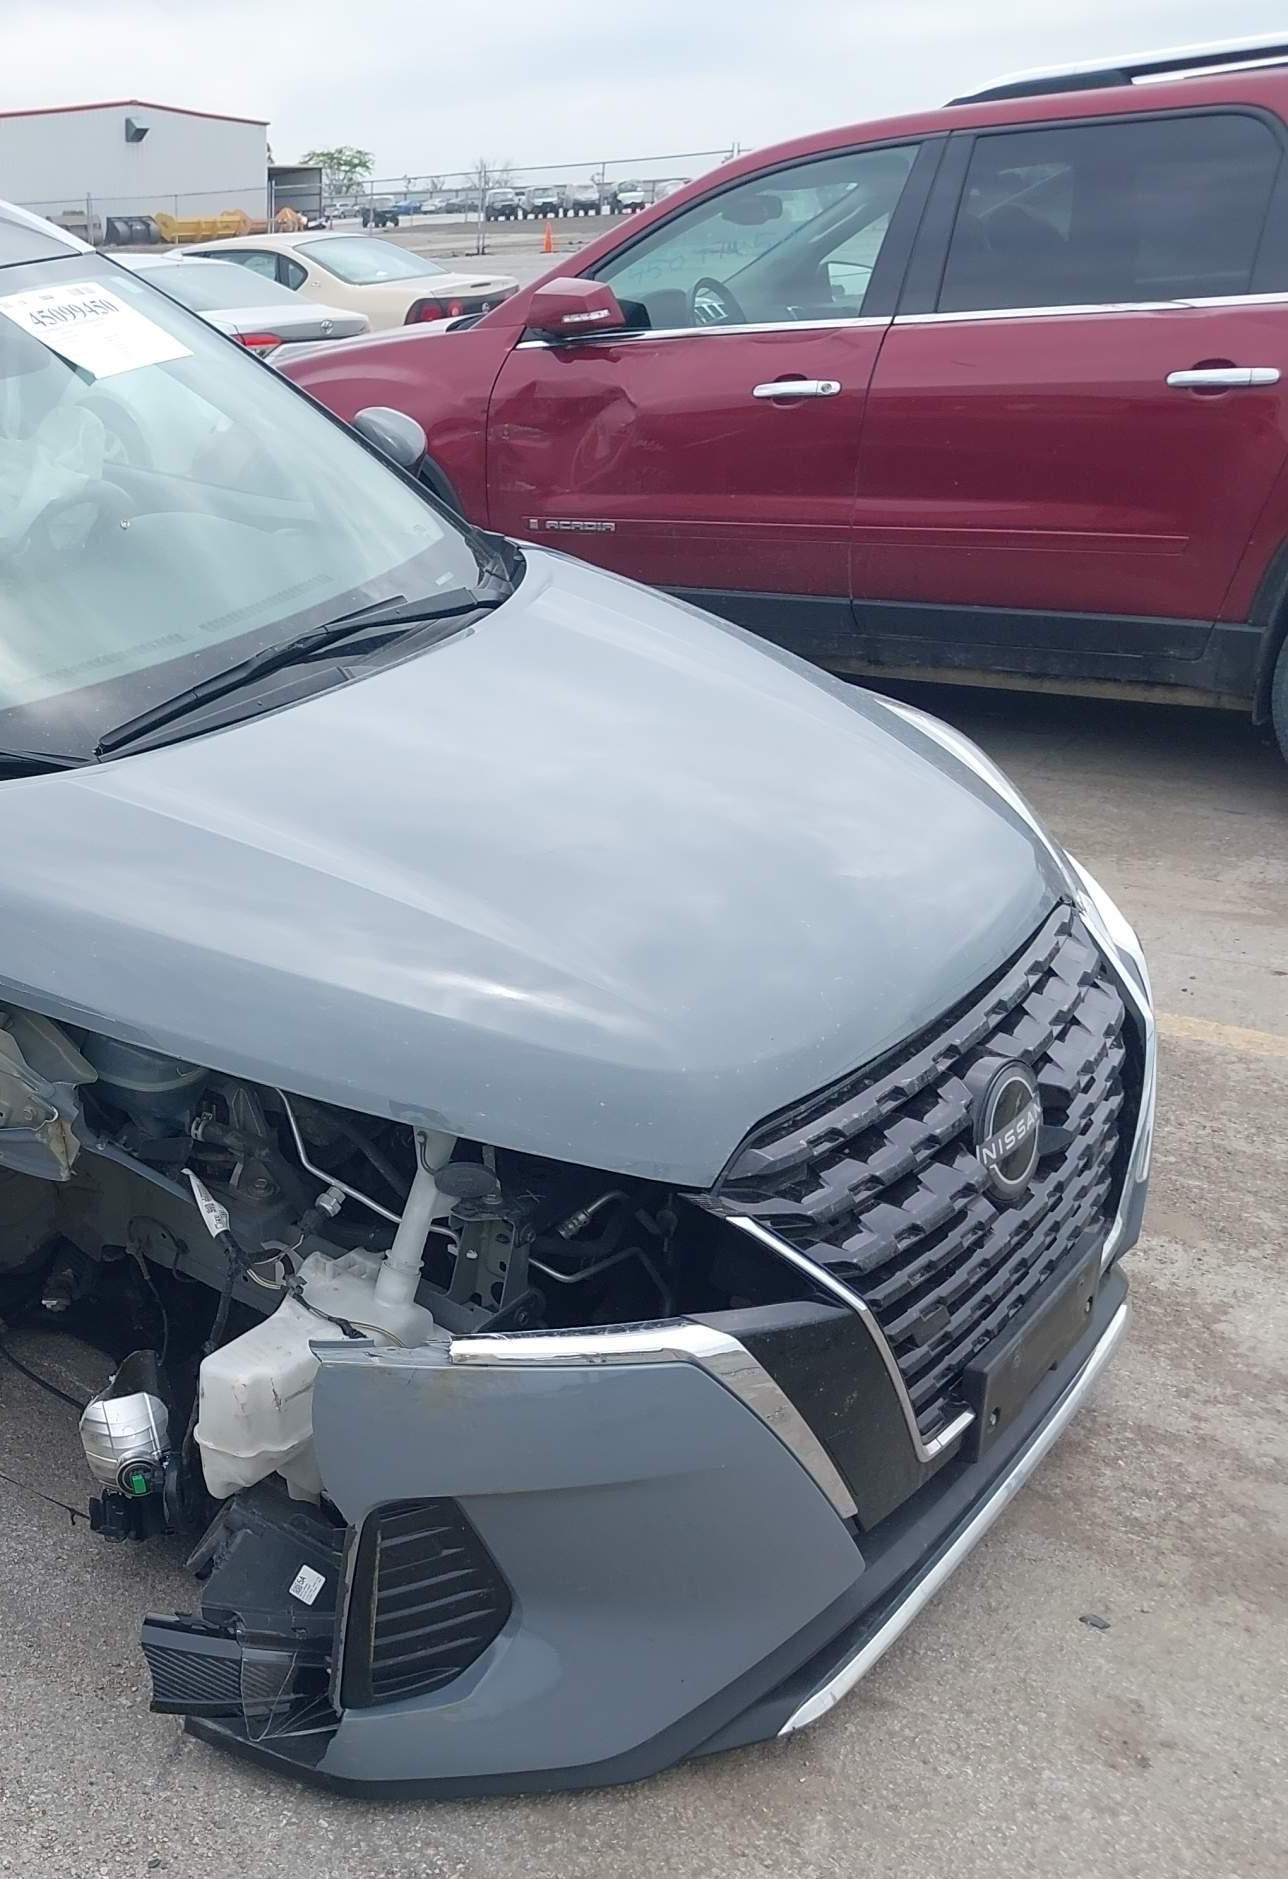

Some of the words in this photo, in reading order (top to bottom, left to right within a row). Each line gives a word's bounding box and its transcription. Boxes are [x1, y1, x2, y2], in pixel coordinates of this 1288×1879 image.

[29, 299, 119, 326] 45099450
[545, 520, 616, 532] ACADIA
[981, 1097, 1042, 1165] NISSAN
